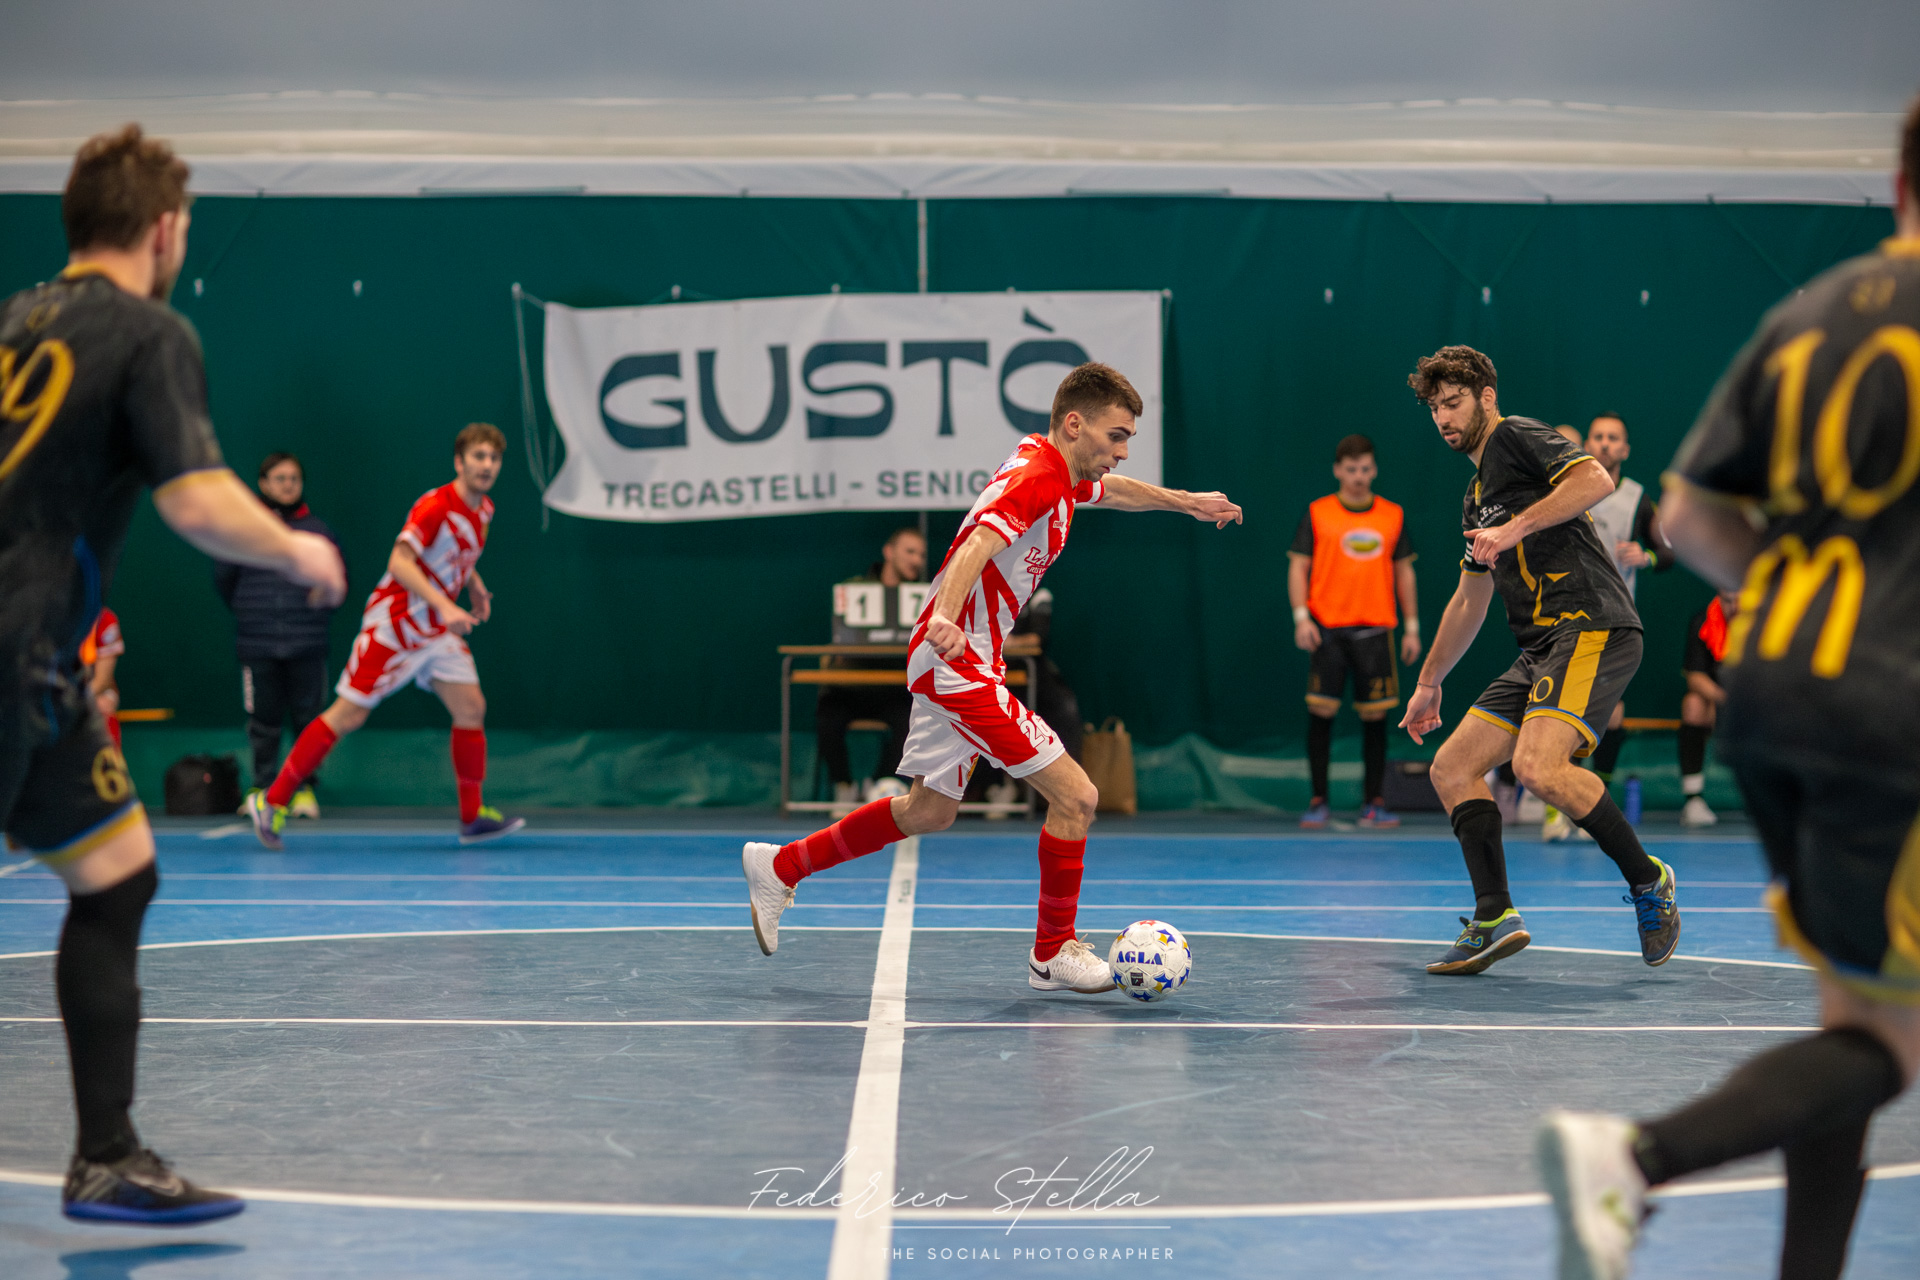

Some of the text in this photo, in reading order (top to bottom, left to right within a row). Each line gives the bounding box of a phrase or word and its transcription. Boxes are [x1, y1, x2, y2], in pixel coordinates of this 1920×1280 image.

[0, 338, 75, 481] 9
[599, 307, 1093, 450] GUSTÒ
[1764, 324, 1920, 519] 10
[603, 470, 836, 508] TRECASTELLI
[857, 592, 924, 619] 1 7
[1116, 950, 1163, 966] AGLA
